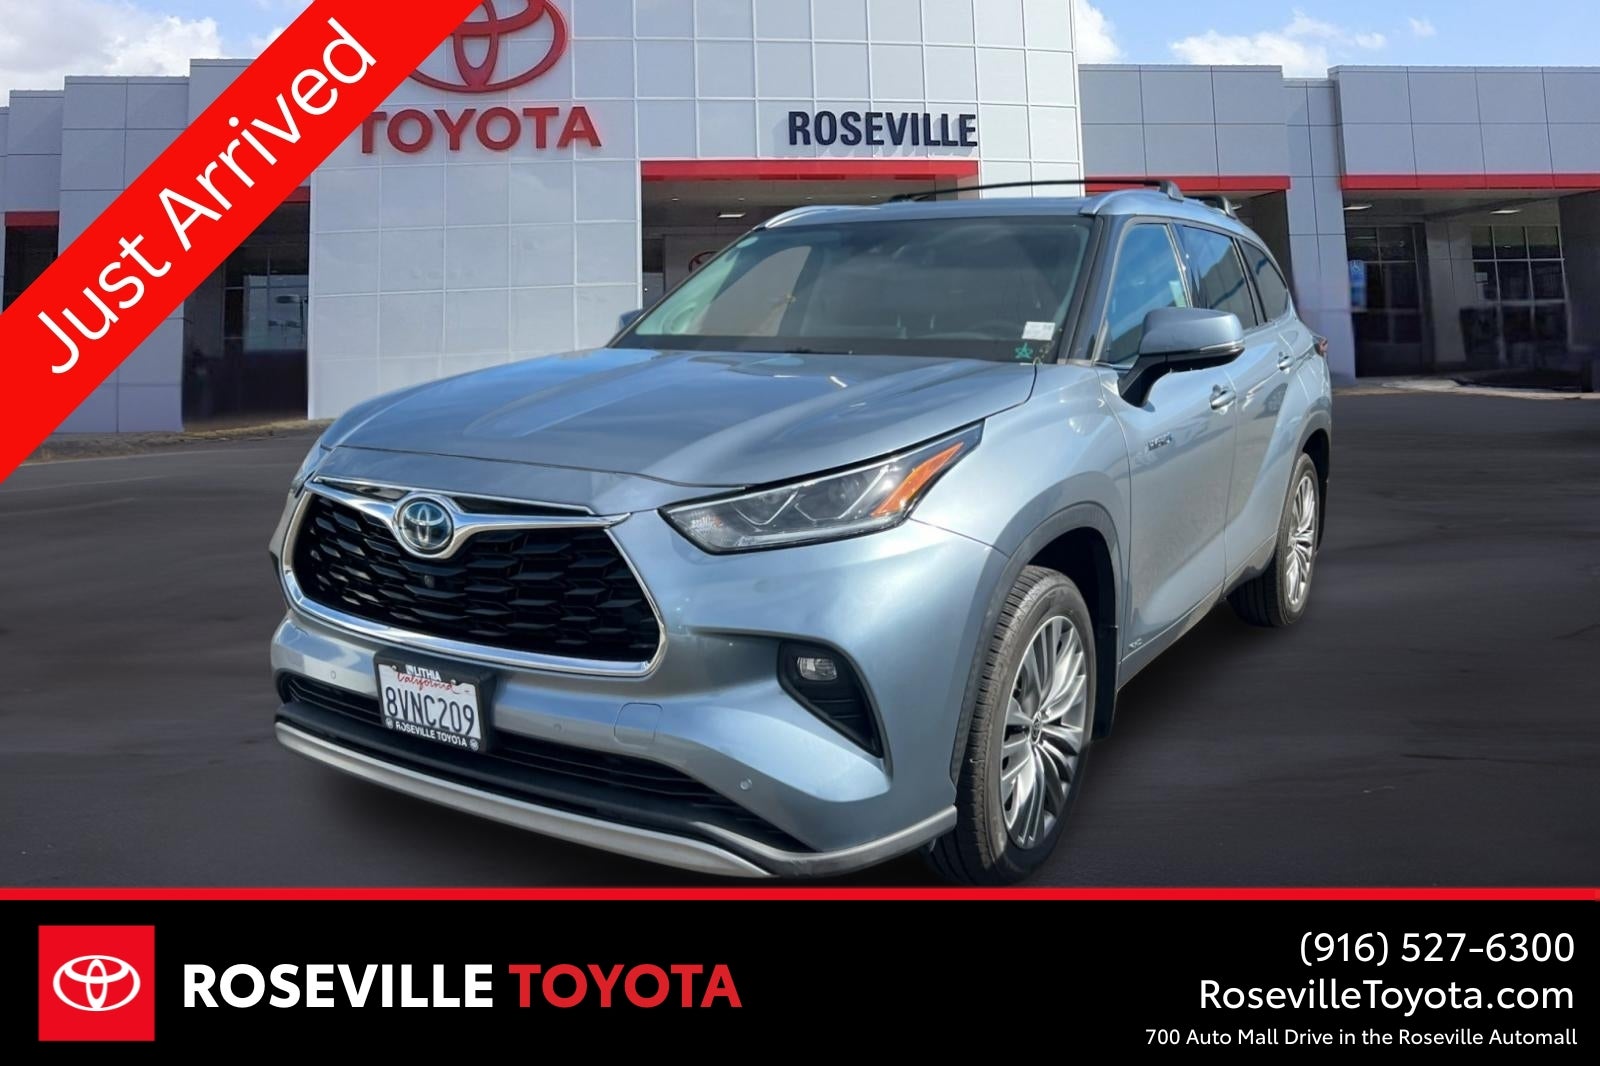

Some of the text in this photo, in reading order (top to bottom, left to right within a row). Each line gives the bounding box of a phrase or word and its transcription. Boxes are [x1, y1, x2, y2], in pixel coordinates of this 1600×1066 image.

[362, 106, 602, 154] TOYOTA
[788, 110, 978, 147] ROSEVILLE
[414, 666, 442, 682] LITHIA
[385, 686, 475, 737] 8VNC209
[395, 720, 468, 748] ROSEVILLE TOYOTA
